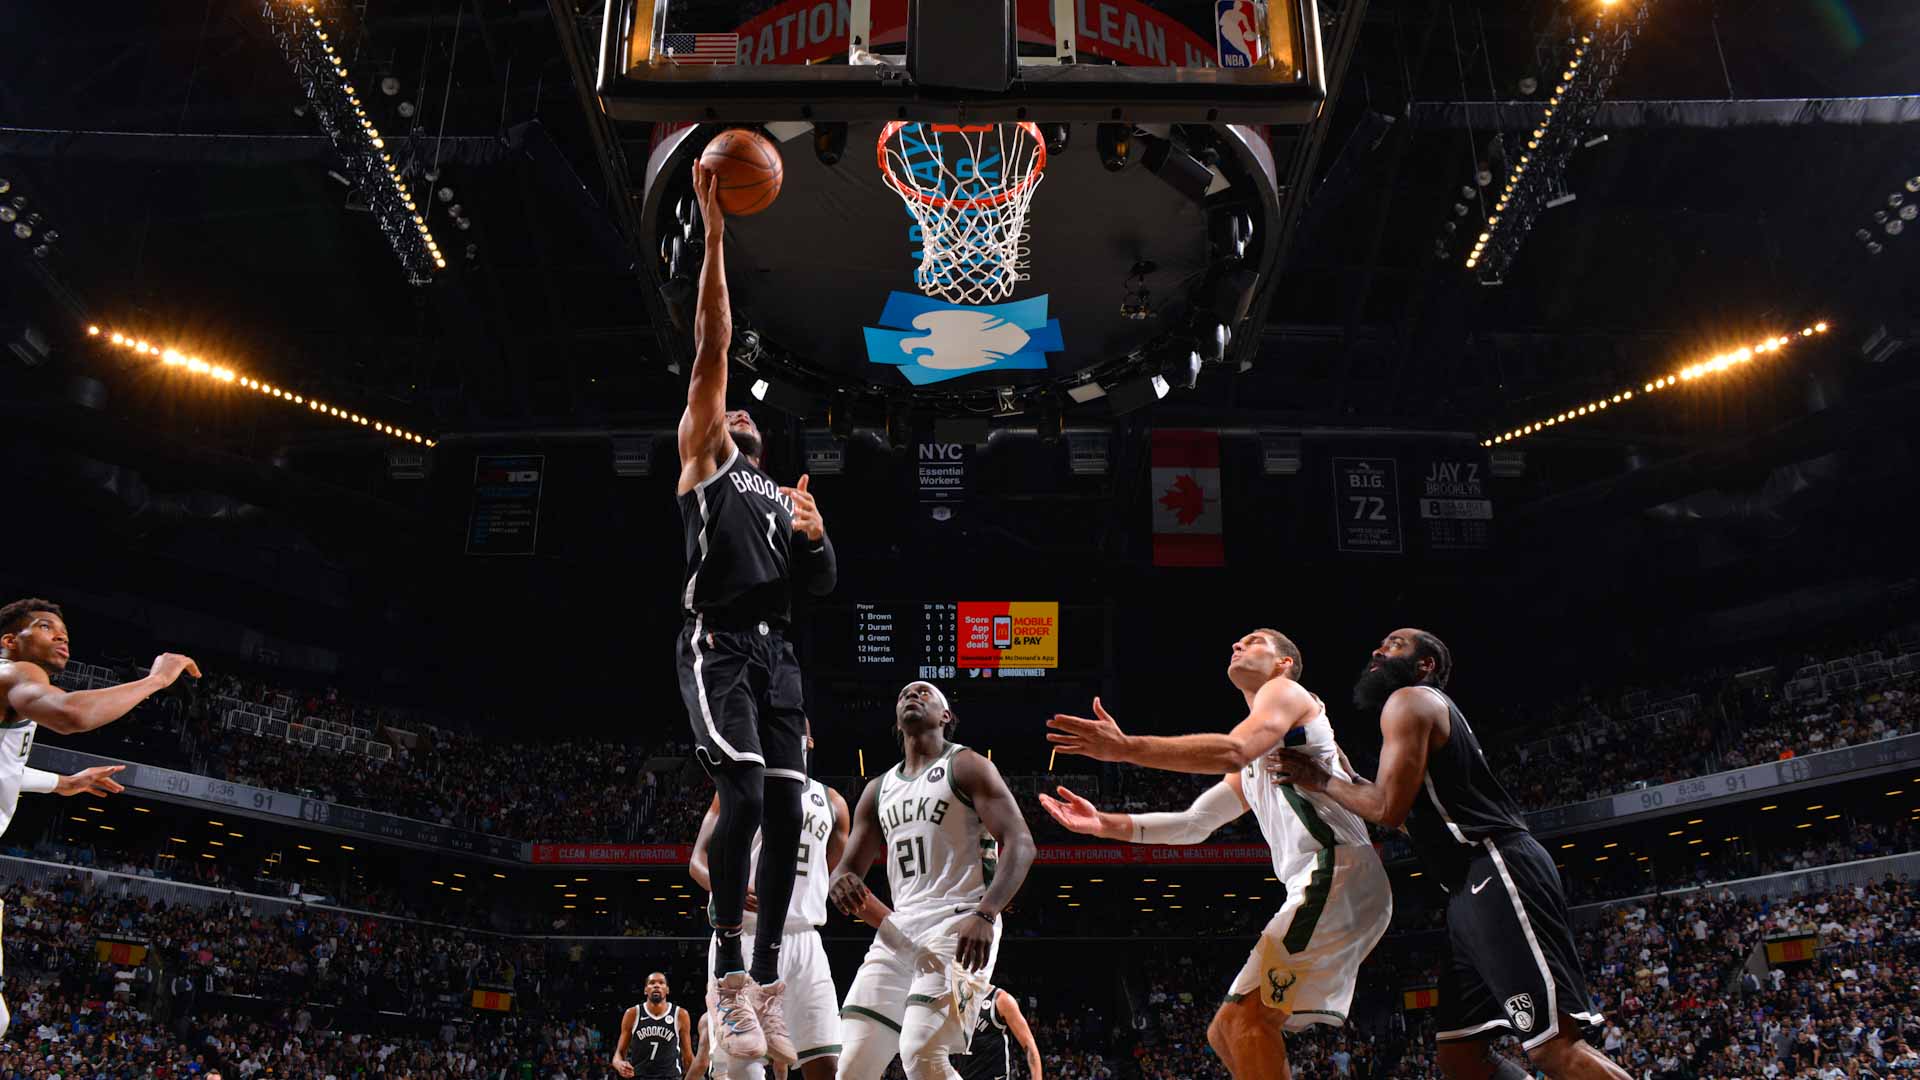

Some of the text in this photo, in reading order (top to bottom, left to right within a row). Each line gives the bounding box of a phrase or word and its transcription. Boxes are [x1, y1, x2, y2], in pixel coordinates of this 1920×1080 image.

[1225, 54, 1245, 67] NBA
[919, 443, 963, 460] NYC
[919, 466, 964, 476] Essential
[1425, 461, 1481, 483] JAY Z
[919, 476, 961, 485] Workers
[1349, 474, 1385, 488] B.I.G.
[1349, 496, 1387, 520] 72
[765, 511, 777, 550] 1
[964, 616, 990, 624] Score
[1014, 617, 1053, 625] MOBILE
[972, 624, 990, 633] App
[1014, 627, 1050, 635] ORDER
[970, 633, 989, 641] only
[1014, 637, 1042, 645] & PAY
[966, 641, 989, 649] deals
[858, 655, 867, 663] 13
[867, 655, 894, 663] Harden
[949, 655, 955, 663] 0
[919, 665, 937, 679] NETS
[168, 775, 190, 793] 90
[253, 793, 273, 810] 91
[1641, 790, 1663, 808] 90
[1726, 773, 1747, 791] 91
[881, 797, 949, 837] BUCKS
[896, 836, 927, 878] 21
[636, 1026, 675, 1042] BROOKLYN
[650, 1041, 659, 1060] 7
